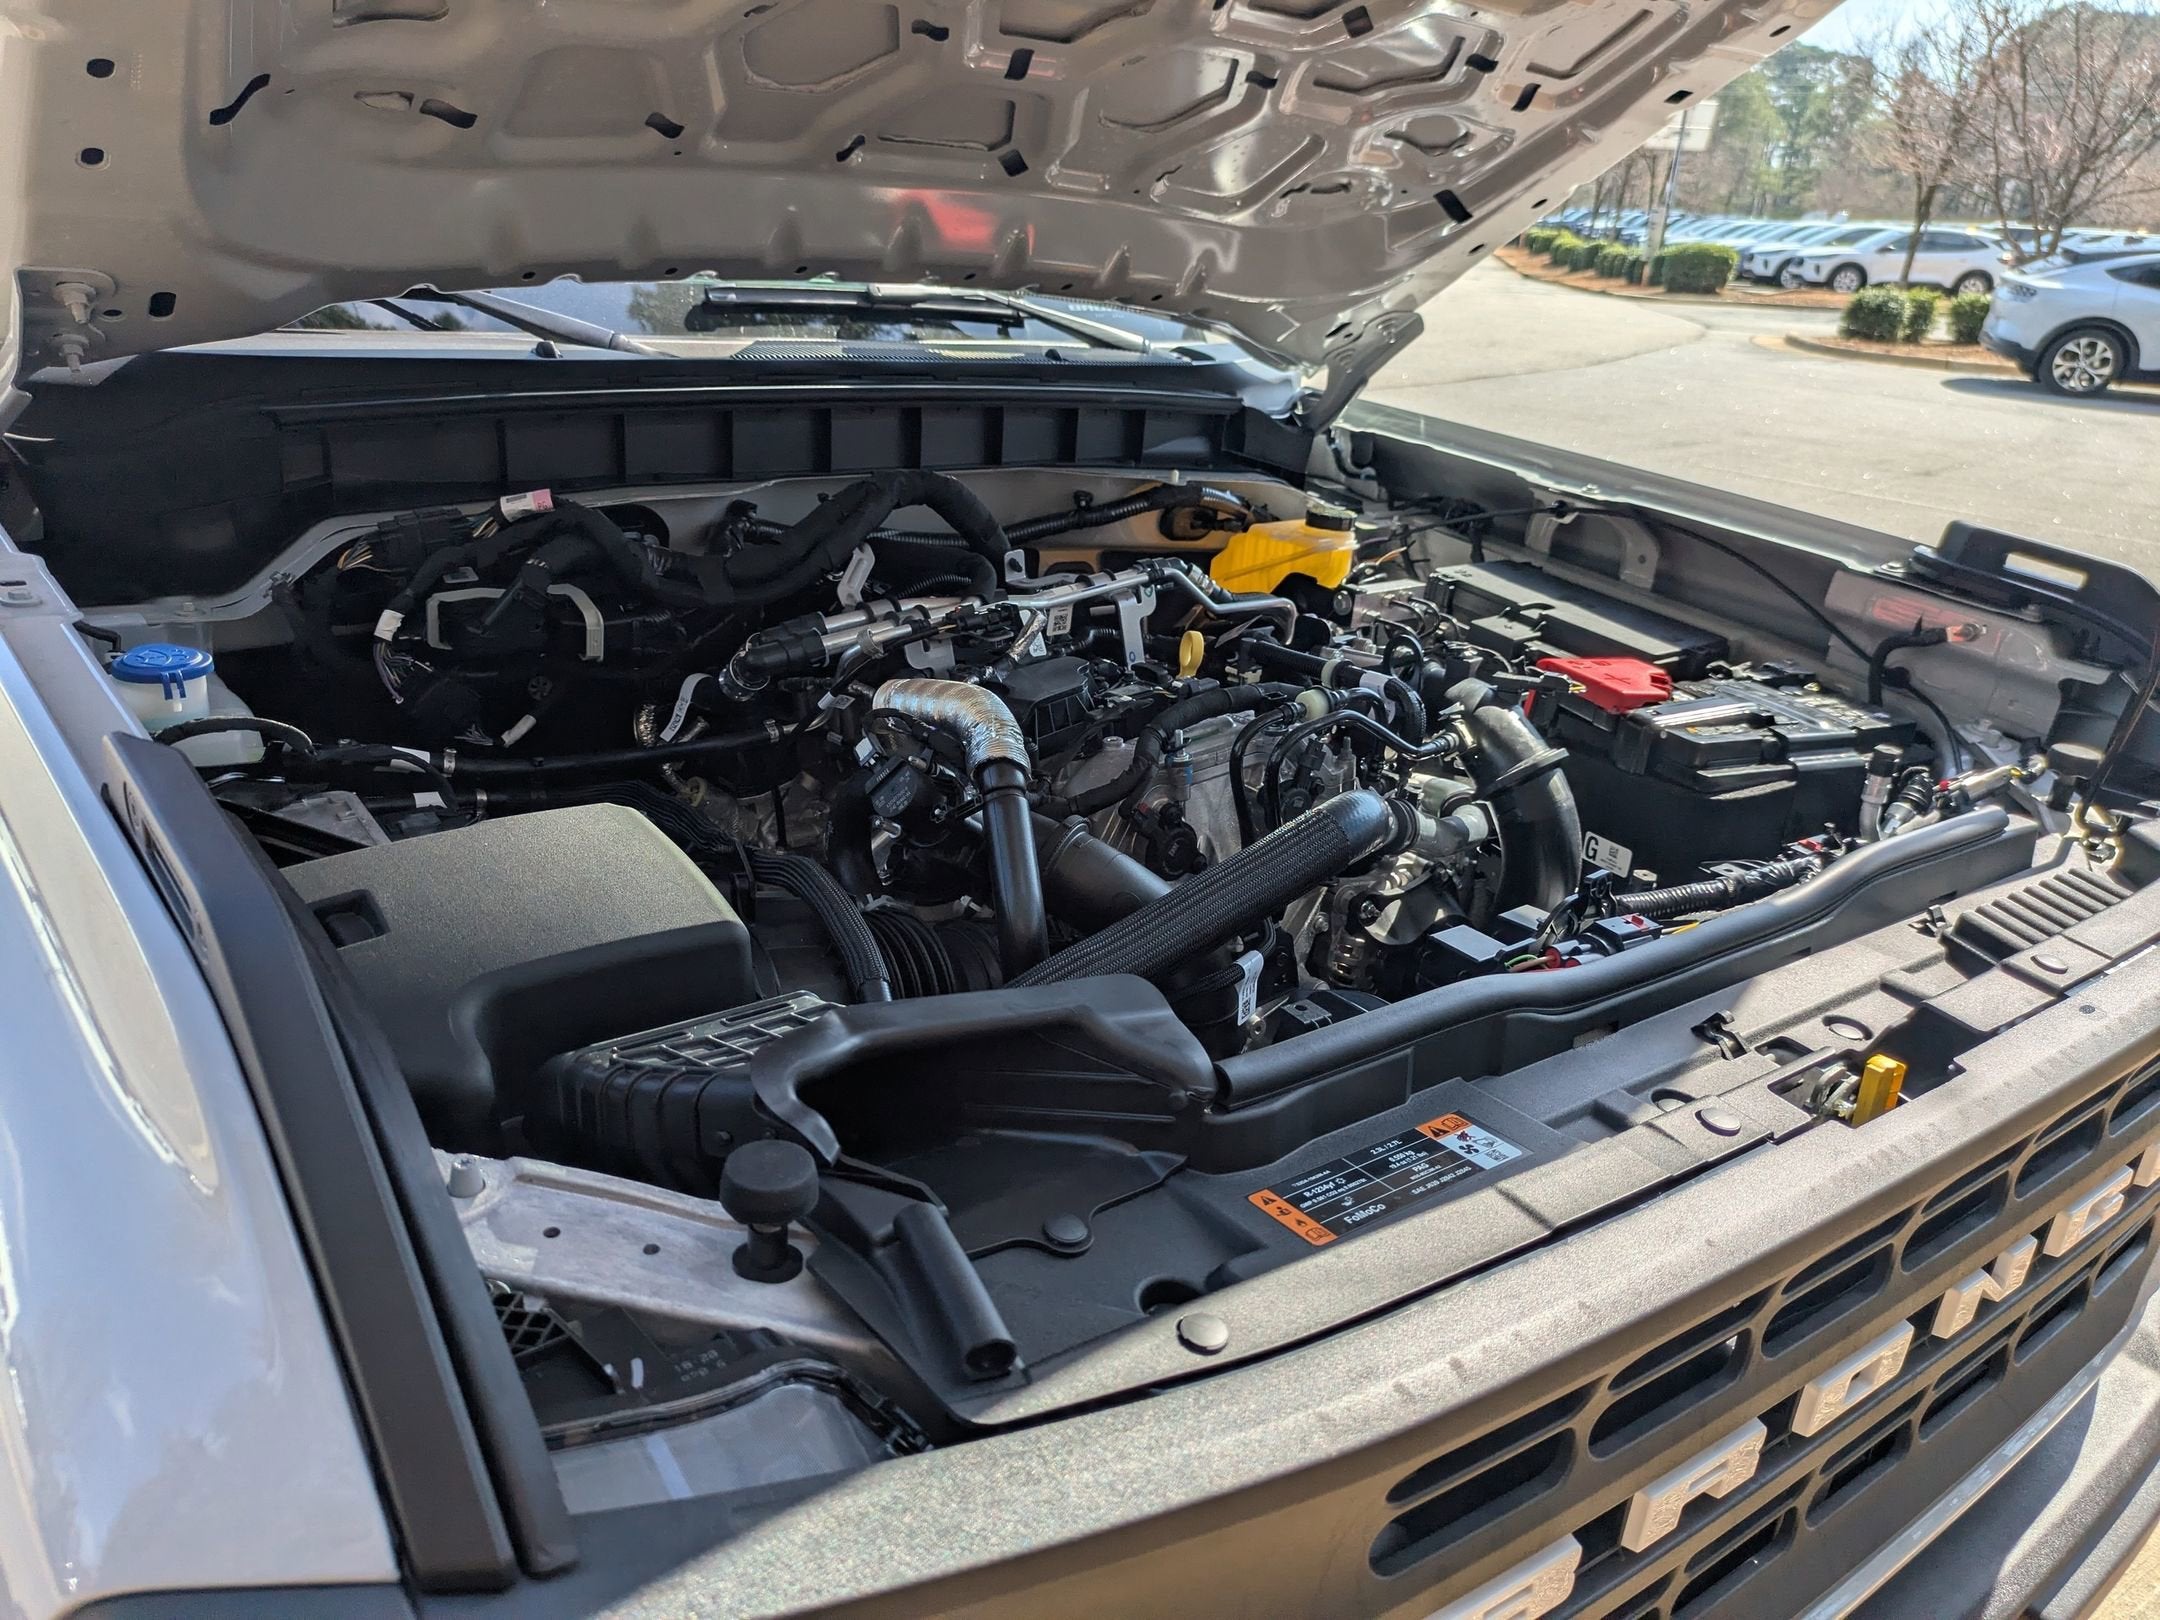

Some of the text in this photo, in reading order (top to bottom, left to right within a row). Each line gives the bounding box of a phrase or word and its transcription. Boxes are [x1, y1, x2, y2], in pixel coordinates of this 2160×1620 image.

[1585, 835, 1599, 862] G
[1412, 1162, 1429, 1172] PAG
[1303, 1181, 1335, 1197] R-1234yf
[1343, 1203, 1386, 1224] FoMoCo
